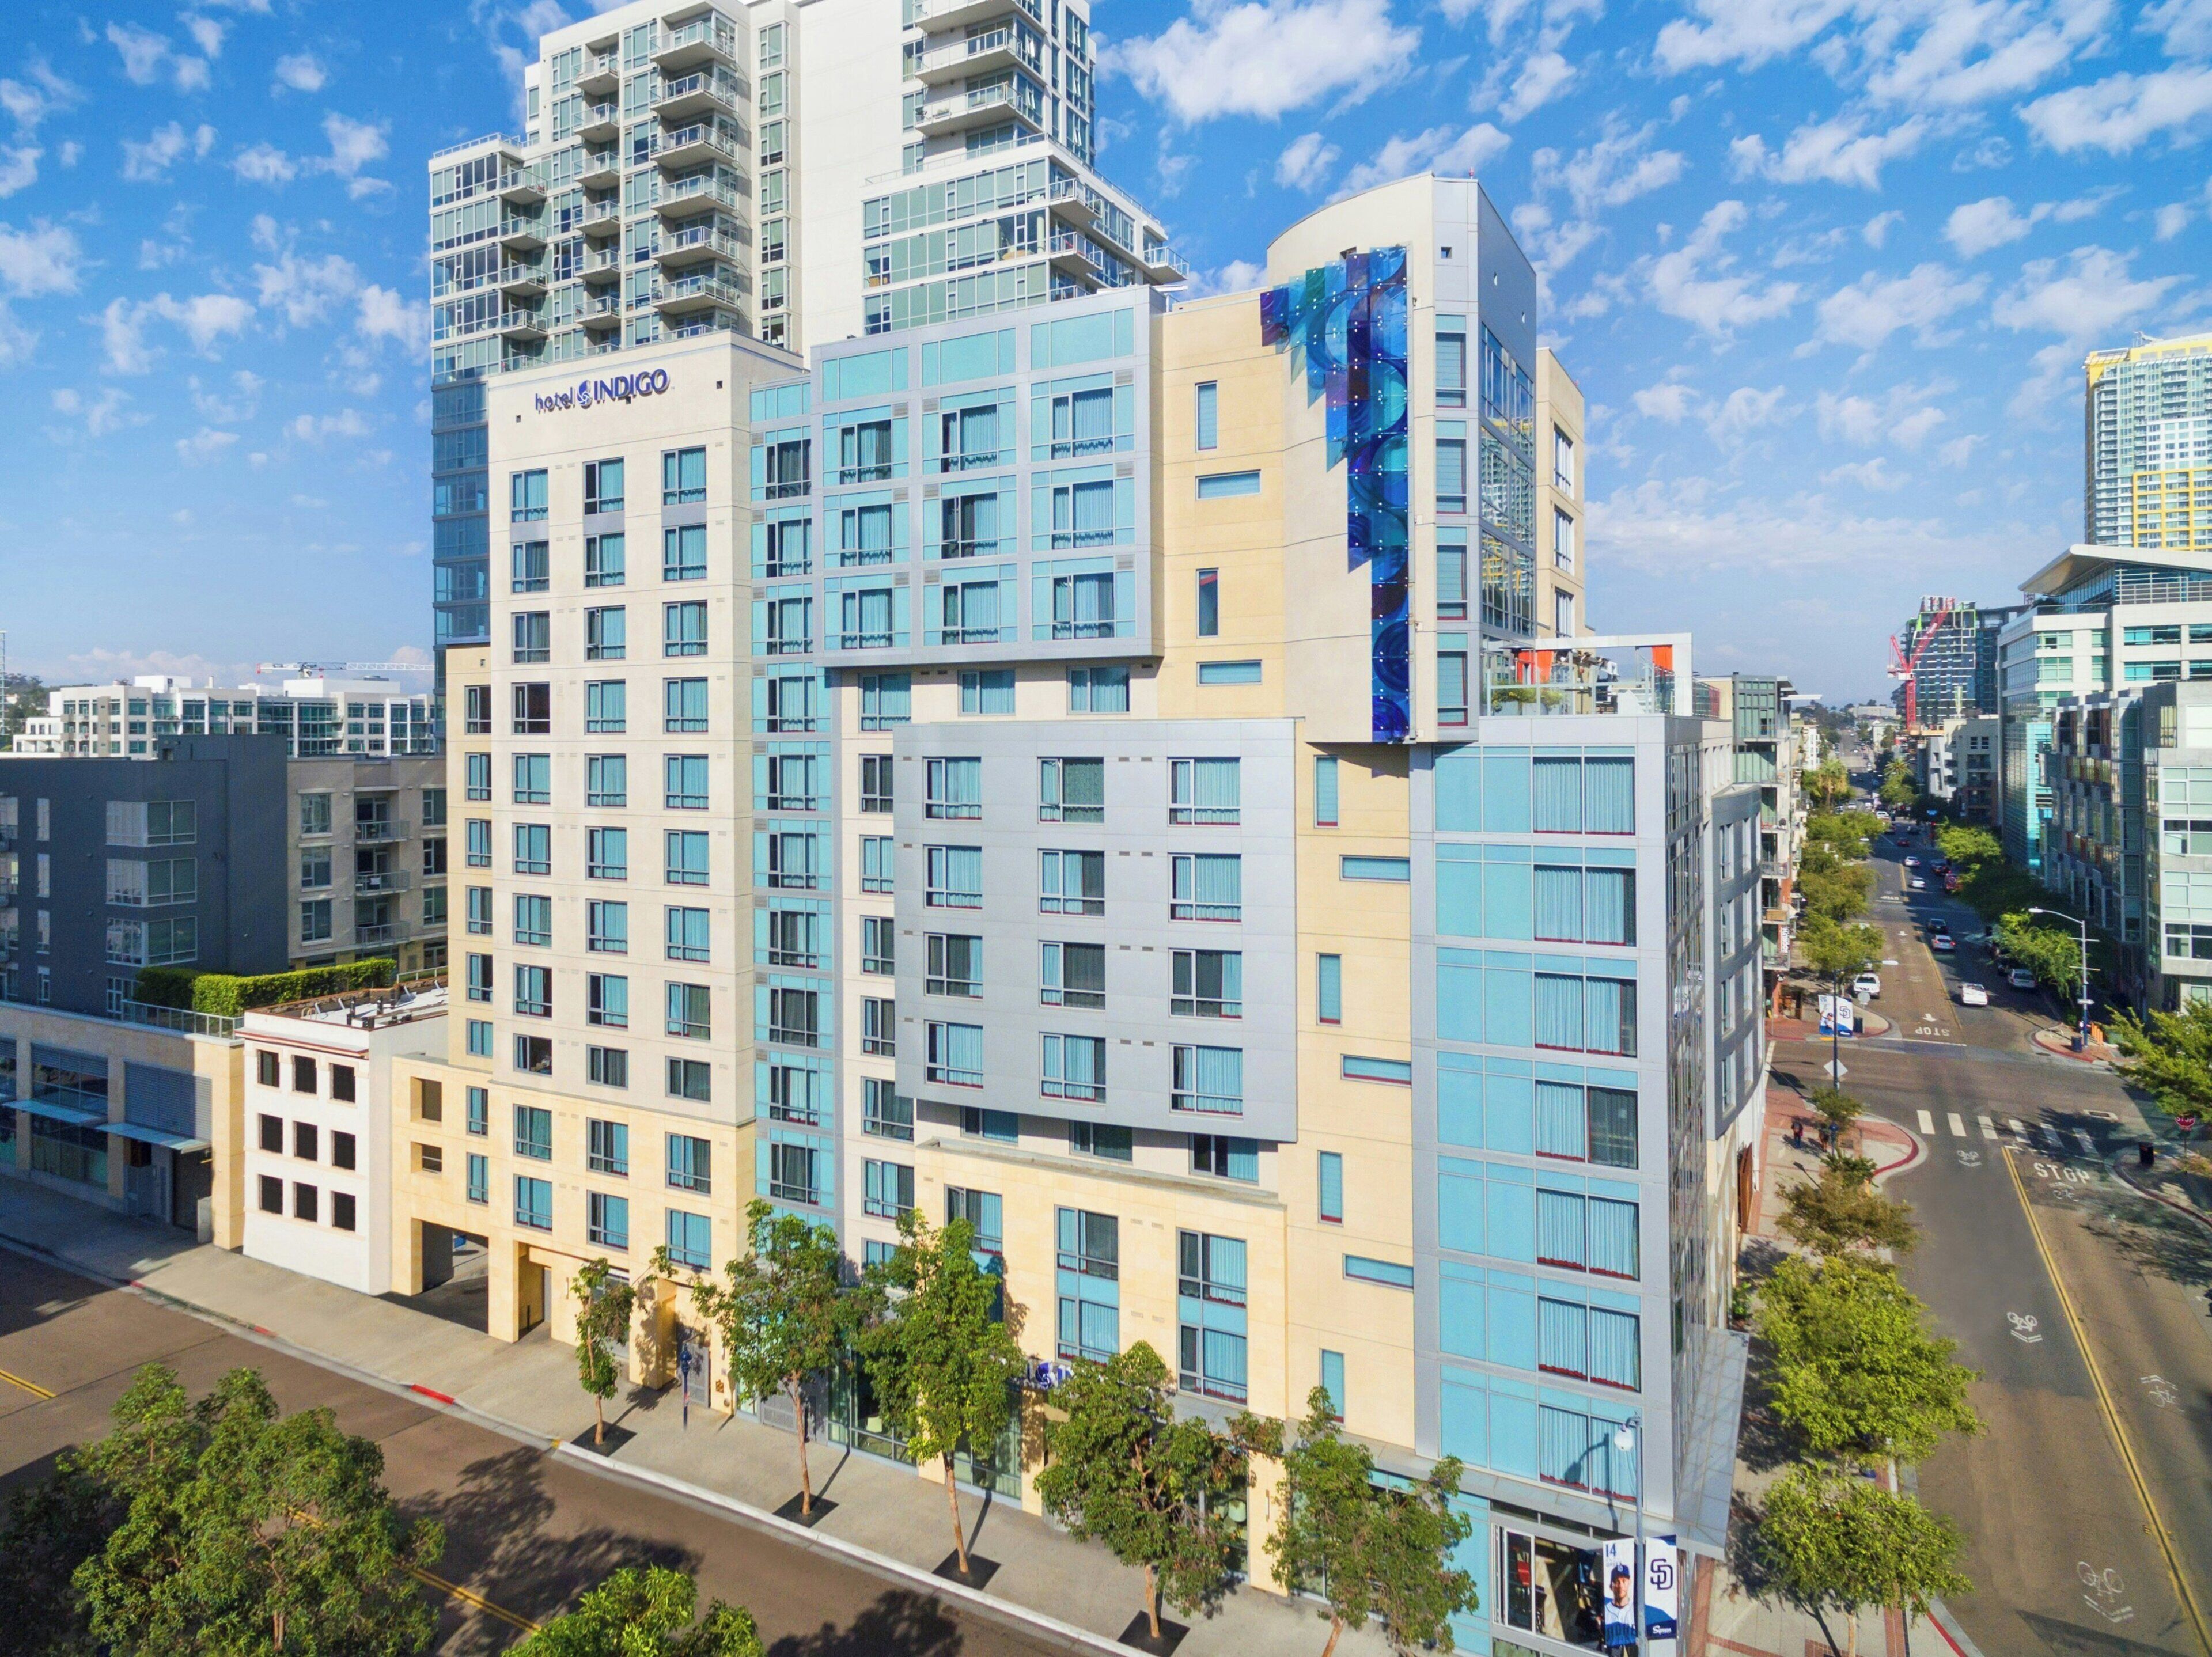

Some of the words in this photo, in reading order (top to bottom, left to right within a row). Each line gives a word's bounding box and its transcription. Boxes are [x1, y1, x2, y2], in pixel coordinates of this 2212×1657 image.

[535, 386, 575, 412] hotel
[593, 369, 669, 401] INDIGO
[1839, 1006, 1851, 1019] SD
[1915, 1026, 1950, 1036] STOP
[2033, 1162, 2090, 1184] STOP
[1605, 1543, 1617, 1557] 14
[1650, 1558, 1673, 1590] SD
